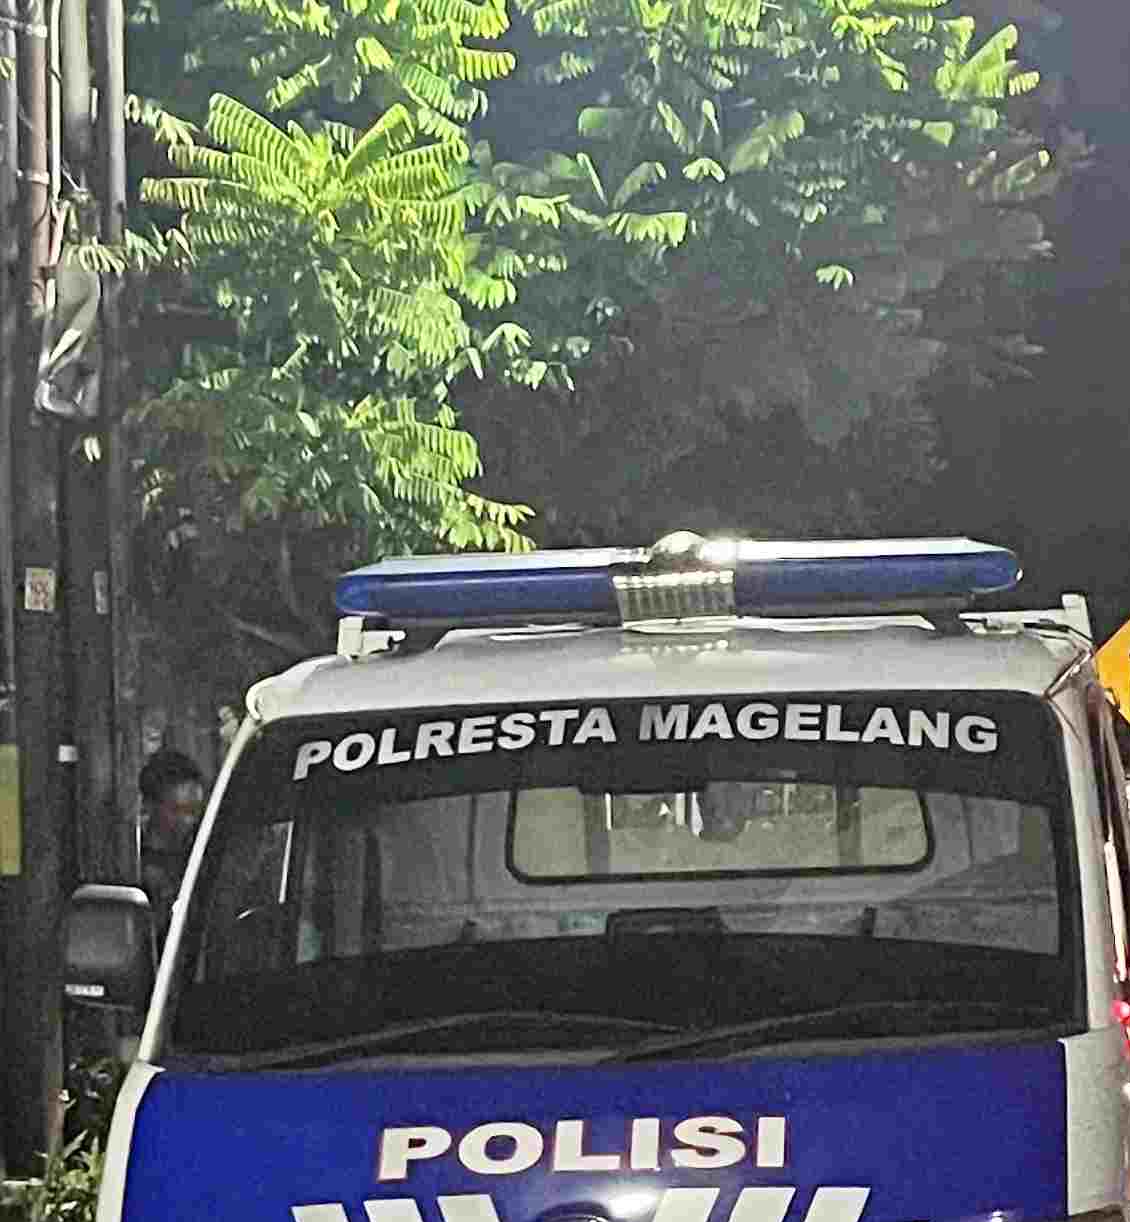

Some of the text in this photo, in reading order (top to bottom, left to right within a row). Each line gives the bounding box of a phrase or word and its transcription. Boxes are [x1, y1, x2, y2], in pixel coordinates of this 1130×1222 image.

[293, 702, 999, 781] POLRESTA MAGELANG
[377, 1116, 786, 1181] POLISI
